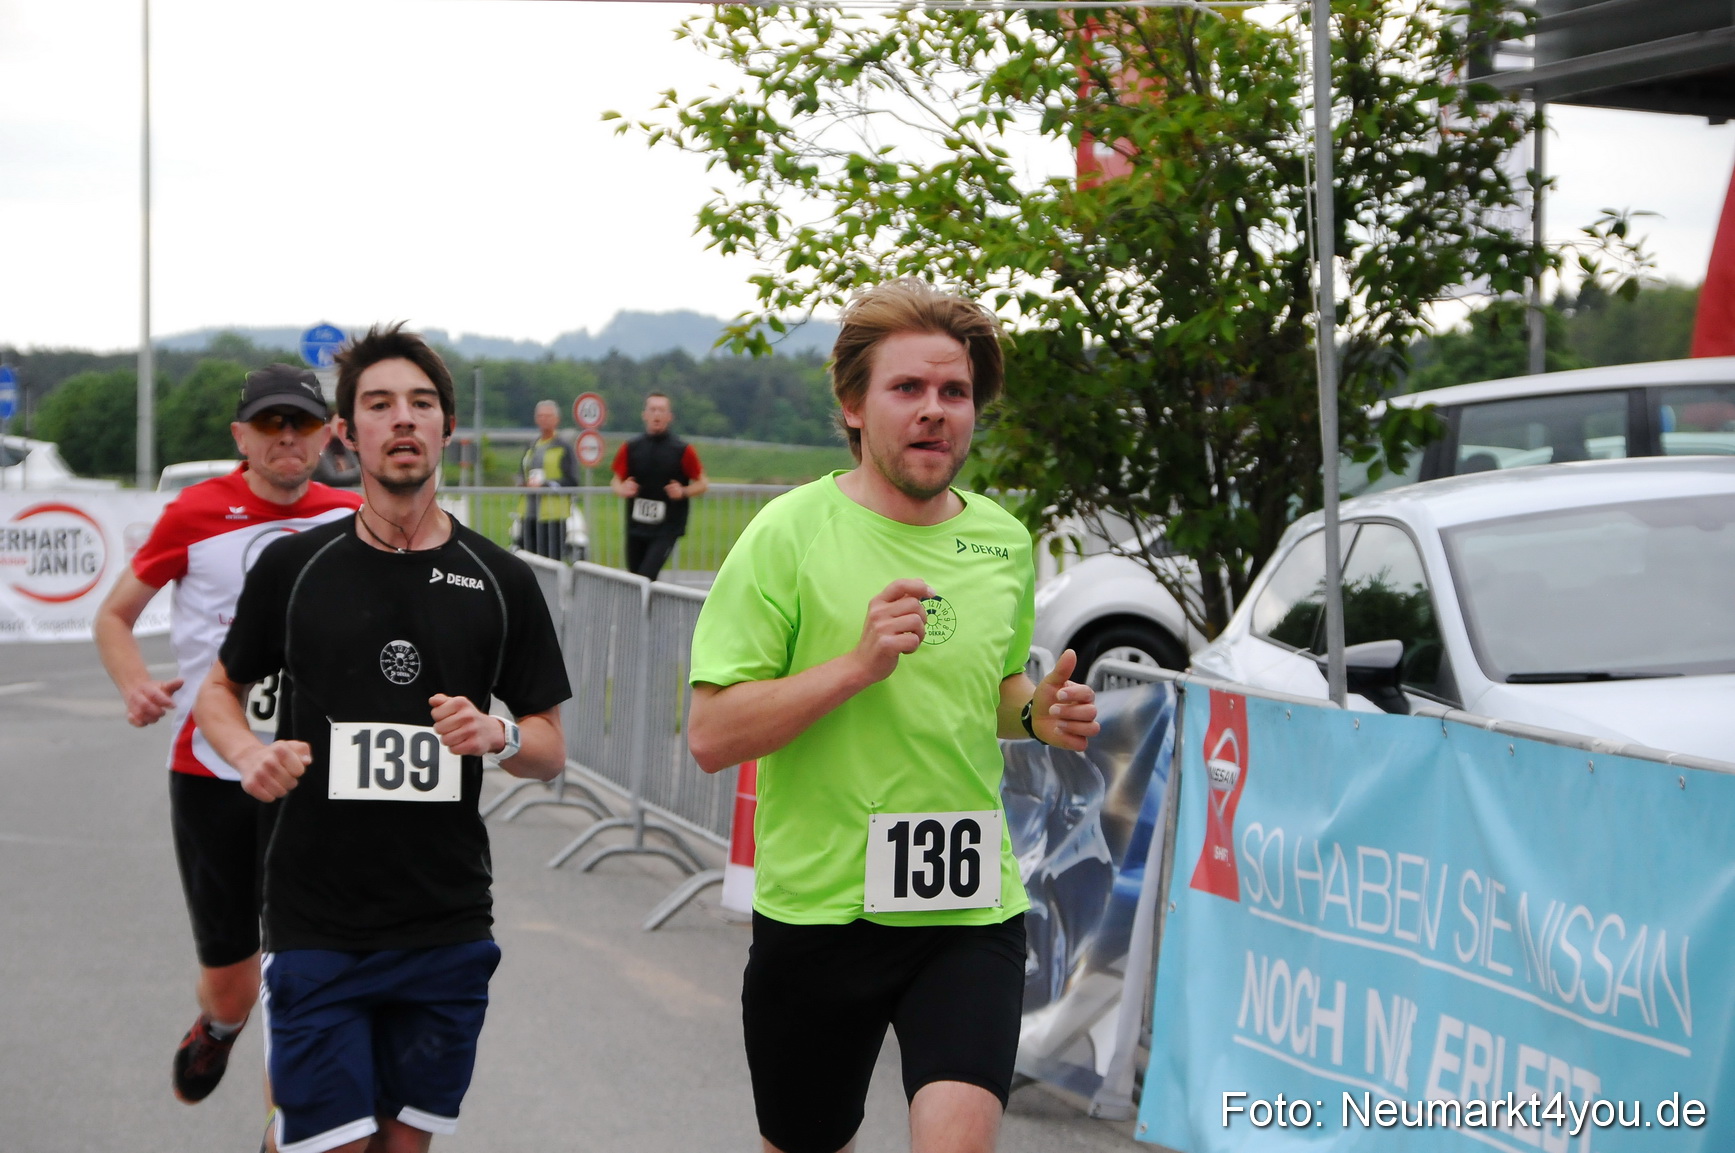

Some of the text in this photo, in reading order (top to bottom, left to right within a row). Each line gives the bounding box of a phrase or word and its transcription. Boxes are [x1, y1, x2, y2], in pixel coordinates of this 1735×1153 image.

[446, 572, 485, 591] DEKRA
[970, 543, 1009, 560] DEKRA
[351, 728, 440, 792] 139
[1209, 765, 1237, 785] NISSAN
[887, 818, 981, 899] 136
[1242, 822, 1693, 1038] SO HABEN SIE NISSAN
[1238, 950, 1346, 1067] NOCH
